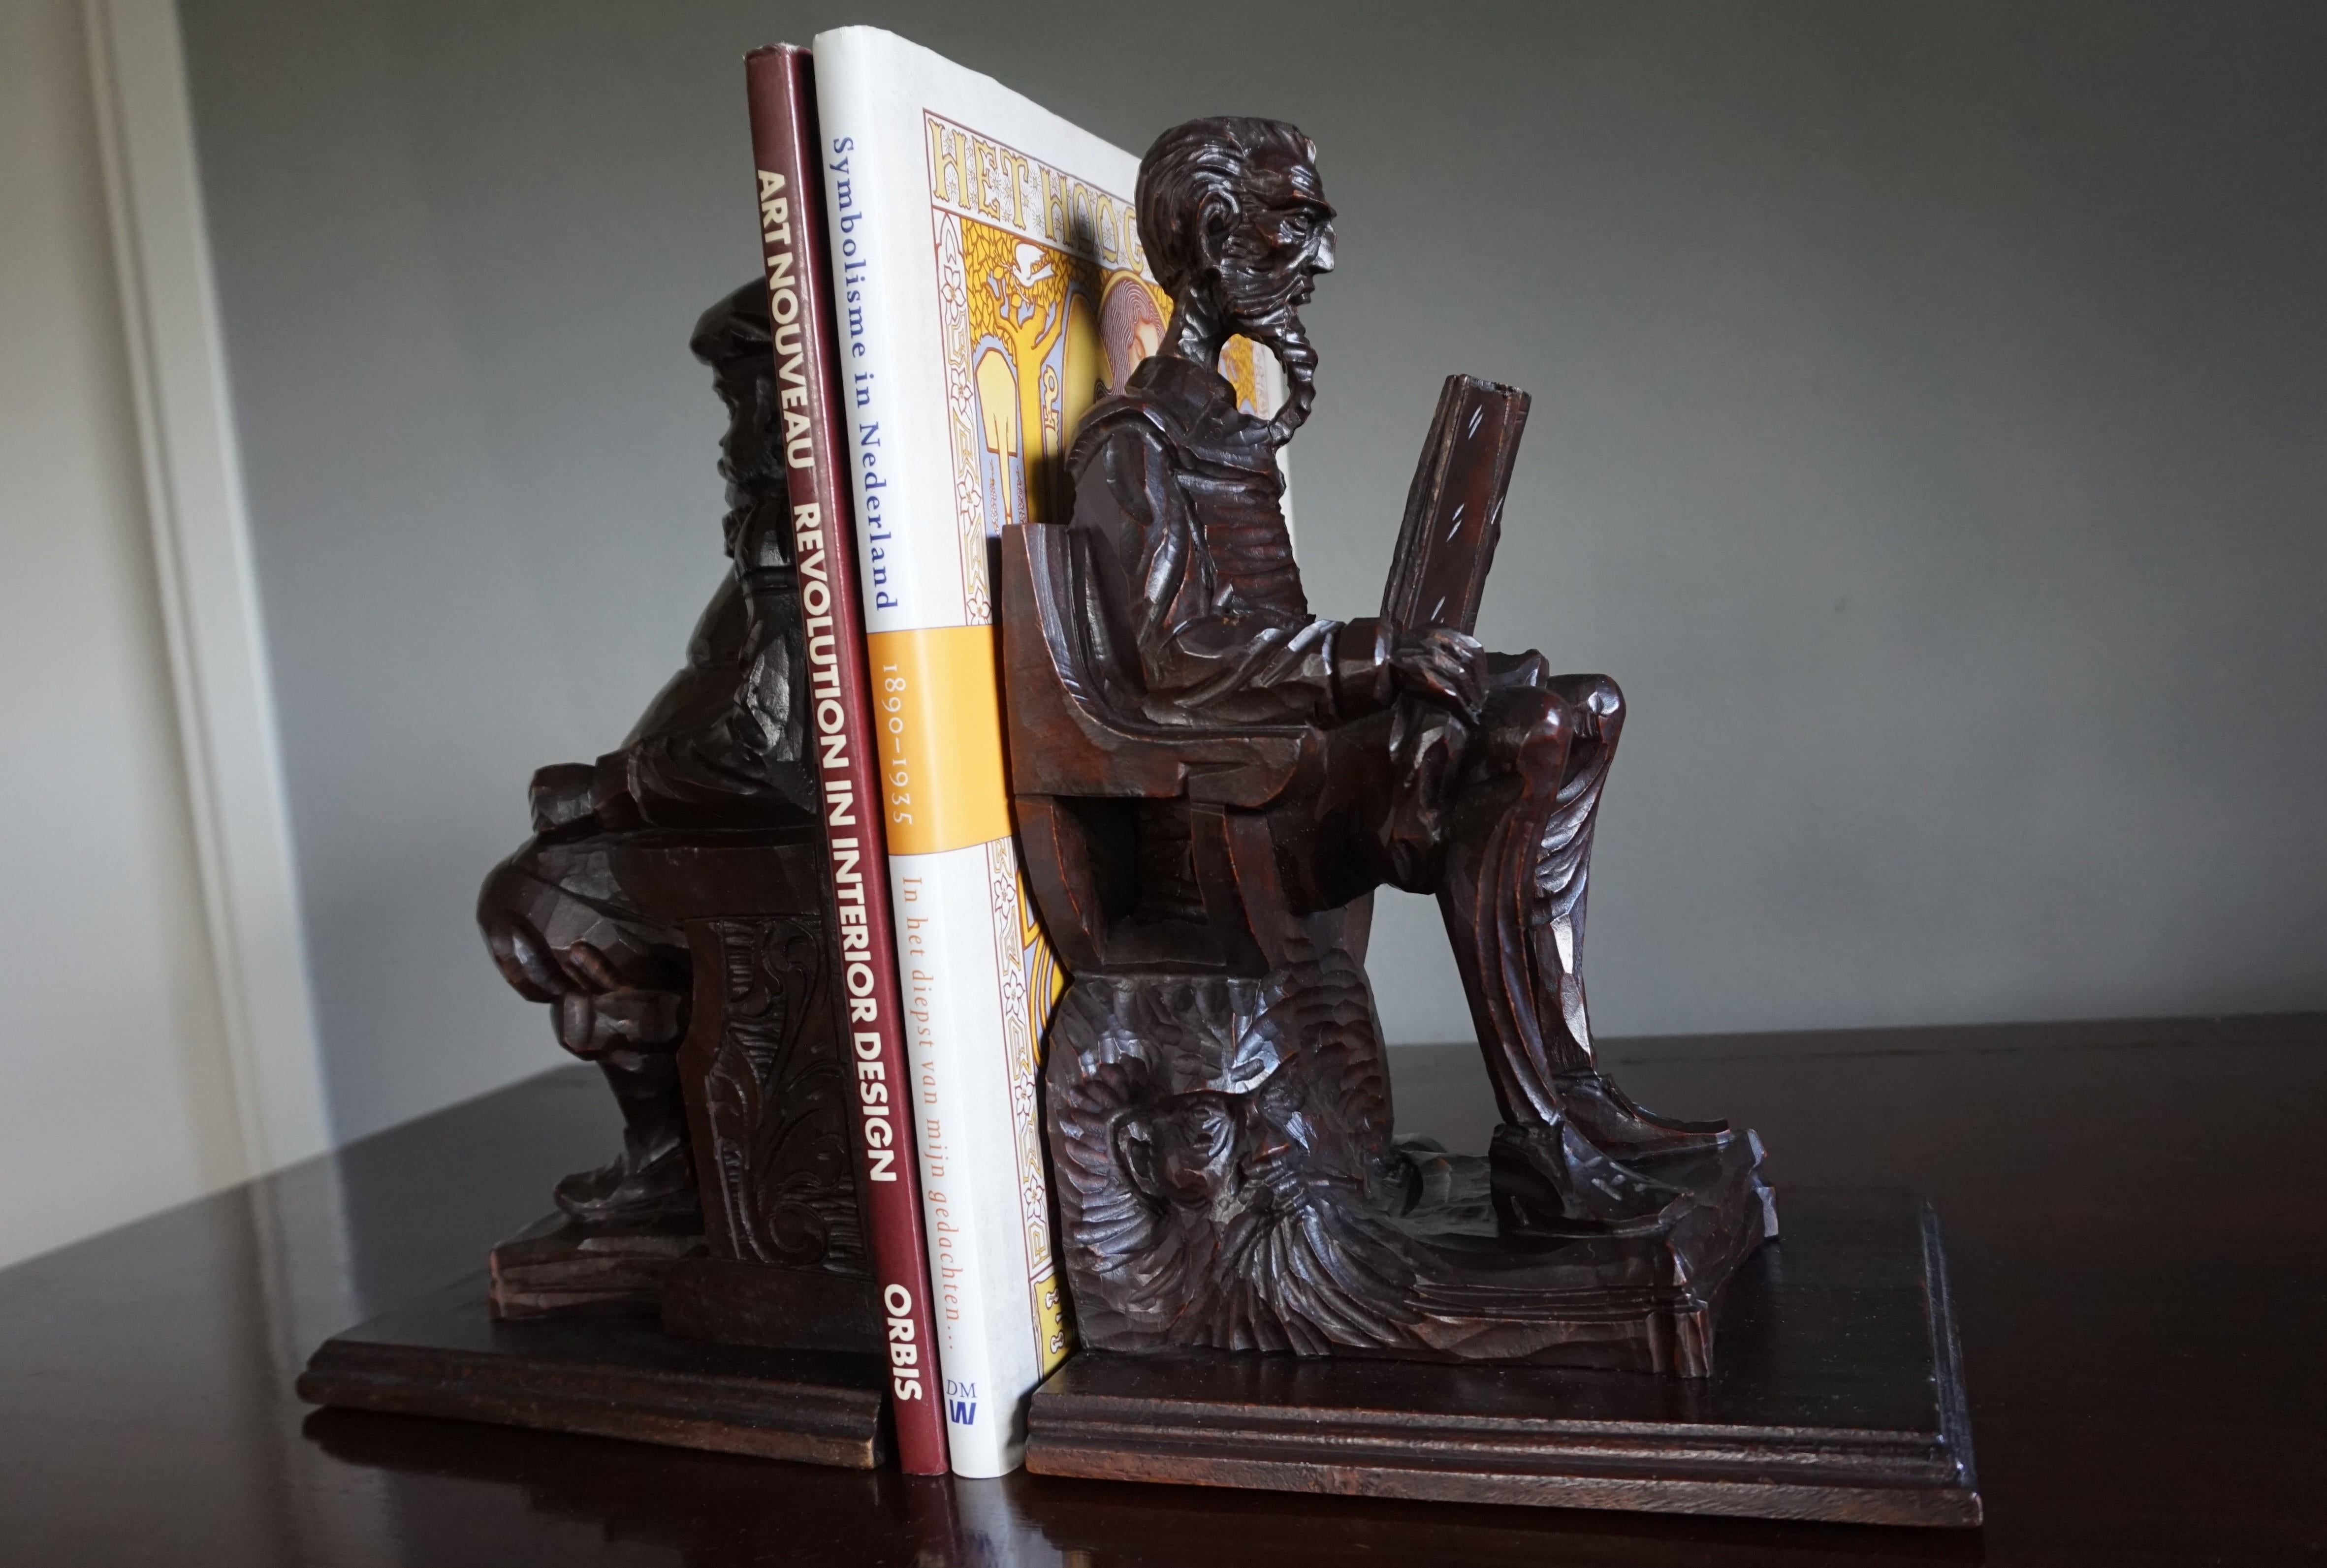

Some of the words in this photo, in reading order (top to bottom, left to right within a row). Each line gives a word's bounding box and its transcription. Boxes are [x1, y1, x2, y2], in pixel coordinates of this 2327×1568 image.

[758, 169, 792, 245] ART
[928, 118, 1029, 231] HET
[829, 136, 867, 358] Symbolisme
[766, 251, 814, 470] NOUVEAU
[854, 372, 875, 408] in
[859, 421, 898, 612] Nederland
[794, 502, 850, 769] REVOLUTION
[825, 780, 856, 827] IN
[902, 877, 923, 903] In
[831, 837, 878, 1024] INTERIOR
[906, 917, 928, 957] het
[909, 970, 934, 1048] diepst
[853, 1032, 897, 1182] DESIGN
[921, 1060, 939, 1105] van
[924, 1118, 949, 1178] mijn
[884, 1284, 923, 1401] ORBIS
[946, 1379, 978, 1398] DM
[949, 1399, 977, 1425] W
